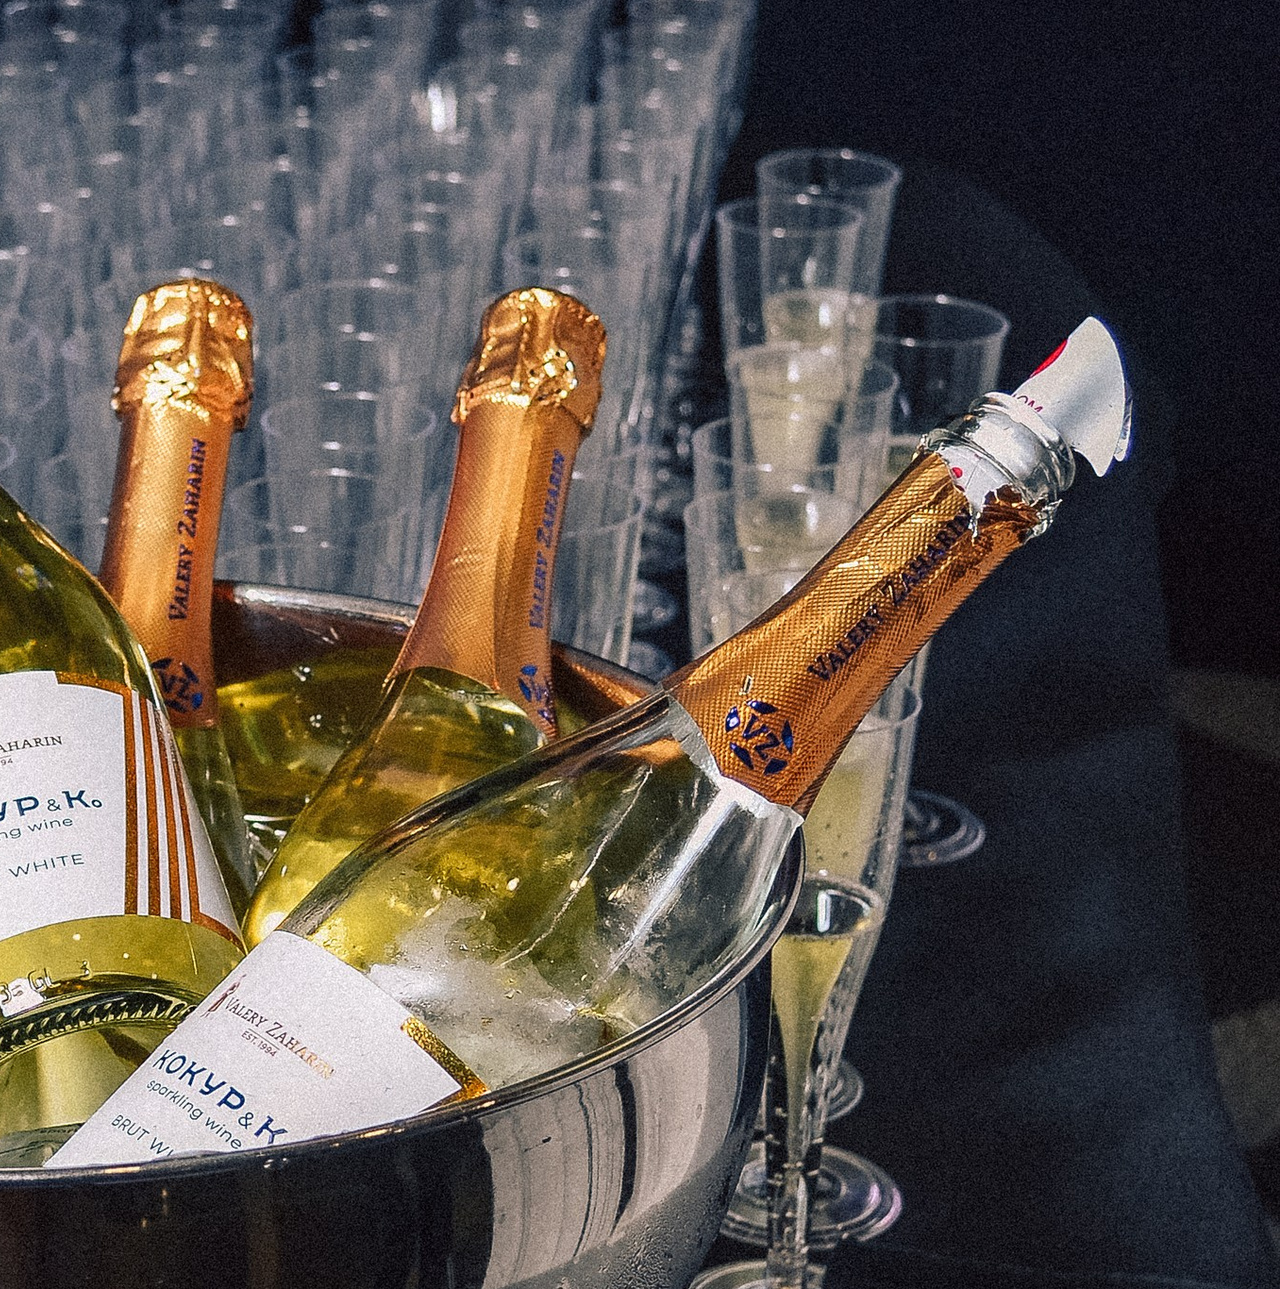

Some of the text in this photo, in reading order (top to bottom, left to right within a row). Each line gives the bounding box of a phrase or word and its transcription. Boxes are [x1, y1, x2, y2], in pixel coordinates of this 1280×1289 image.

[168, 438, 207, 621] VALERY ZAHARIN
[529, 548, 546, 629] VALERY
[806, 605, 884, 681] VALERY
[28, 818, 73, 832] wine
[9, 853, 85, 877] WHITE
[225, 997, 335, 1079] VALERY ZAHARIN
[241, 1031, 277, 1057] EST. 1994
[111, 1114, 150, 1141] BRUT
[146, 1079, 242, 1150] sparkling wine
